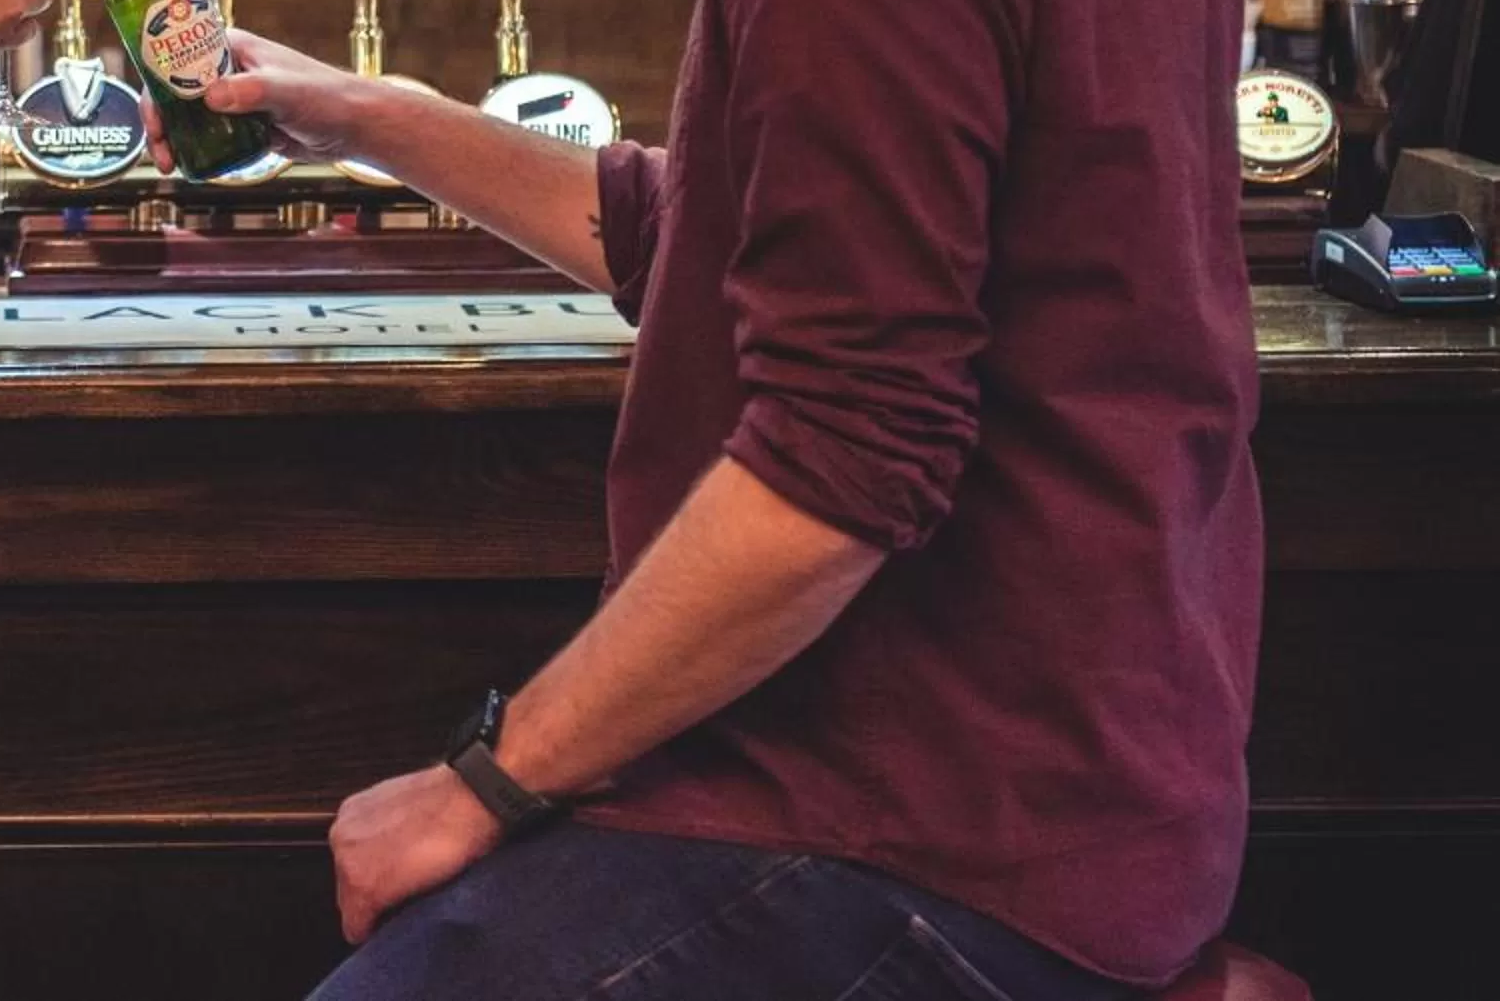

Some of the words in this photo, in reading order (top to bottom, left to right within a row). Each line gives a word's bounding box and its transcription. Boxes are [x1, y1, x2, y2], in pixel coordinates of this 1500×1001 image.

[31, 126, 133, 146] GUINNESS
[461, 301, 618, 317] BU
[235, 323, 508, 335] HOTEL
